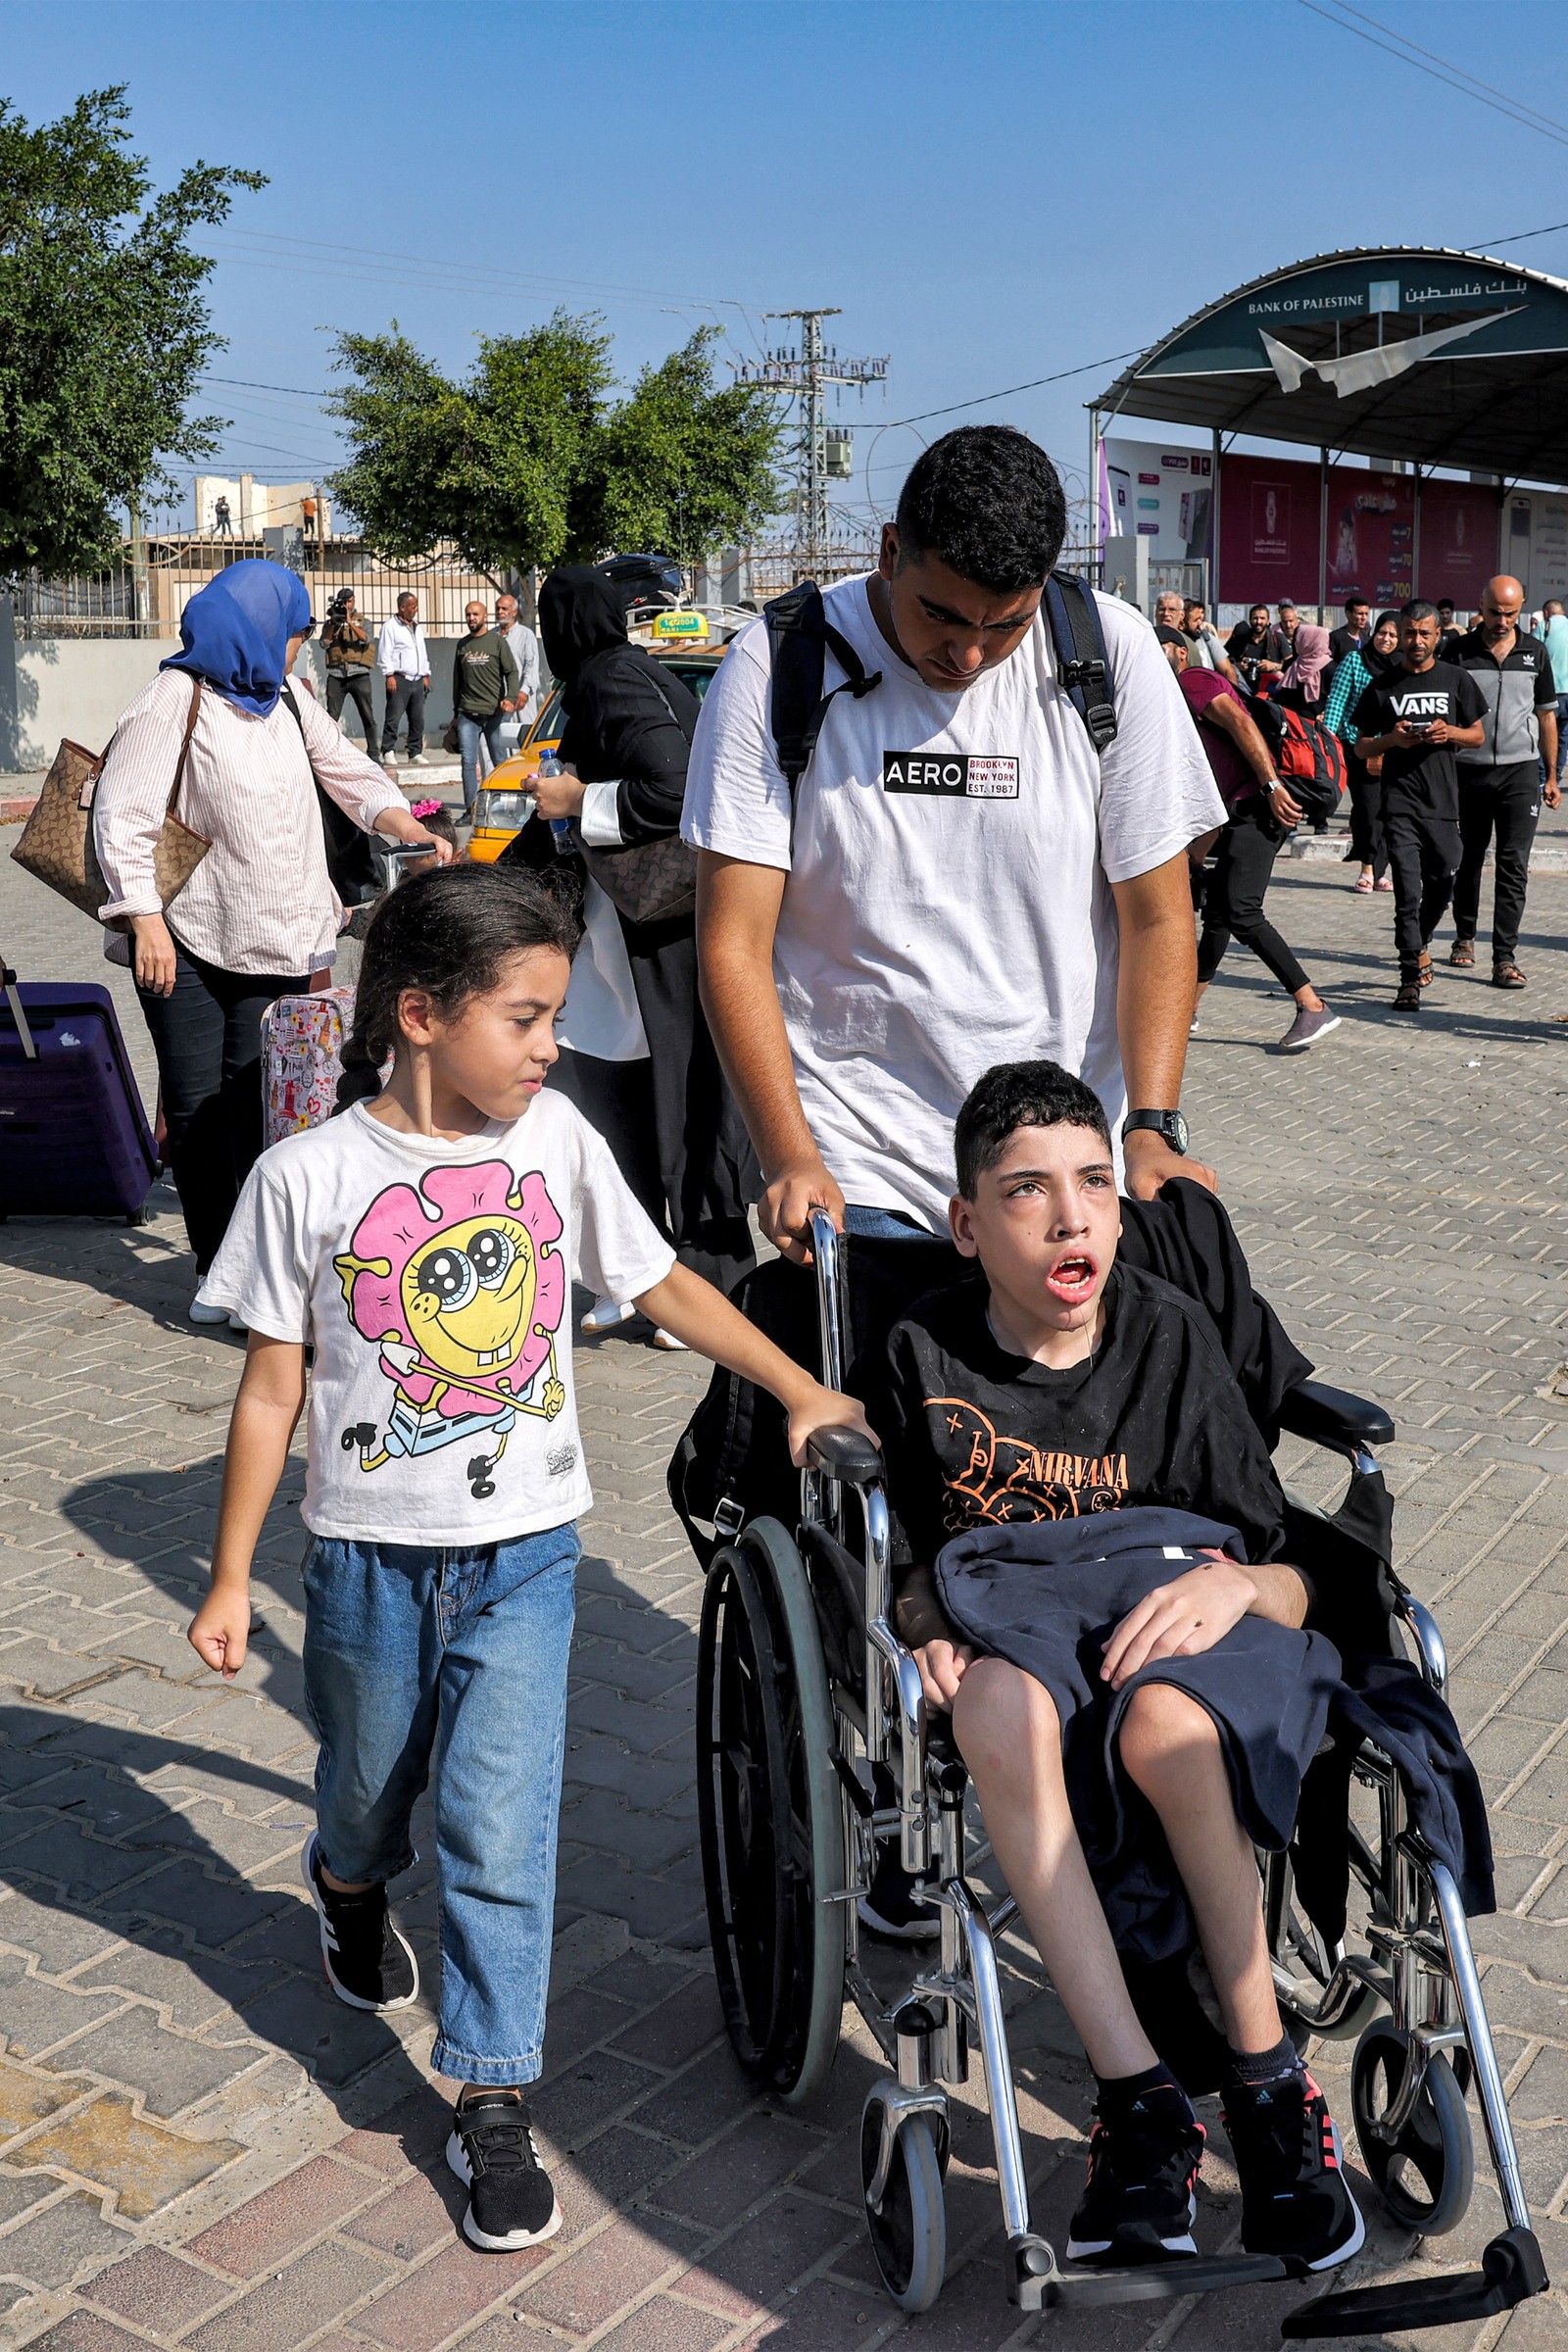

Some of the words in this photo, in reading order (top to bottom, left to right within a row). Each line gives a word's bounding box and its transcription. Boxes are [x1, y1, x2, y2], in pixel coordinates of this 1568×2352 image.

[1405, 283, 1482, 303] فلسطين
[1486, 279, 1527, 294] بنك
[1249, 302, 1281, 314] BANK
[1284, 300, 1300, 311] OF
[1303, 295, 1363, 310] PALESTINE
[1394, 582, 1411, 598] 700
[1389, 692, 1449, 716] VANS
[886, 760, 962, 787] AERO
[969, 760, 1014, 770] BROOKLYN
[968, 772, 989, 781] NEW
[992, 773, 1015, 782] YORK
[968, 784, 987, 793] EST.
[1027, 1450, 1129, 1491] NIRVANA
